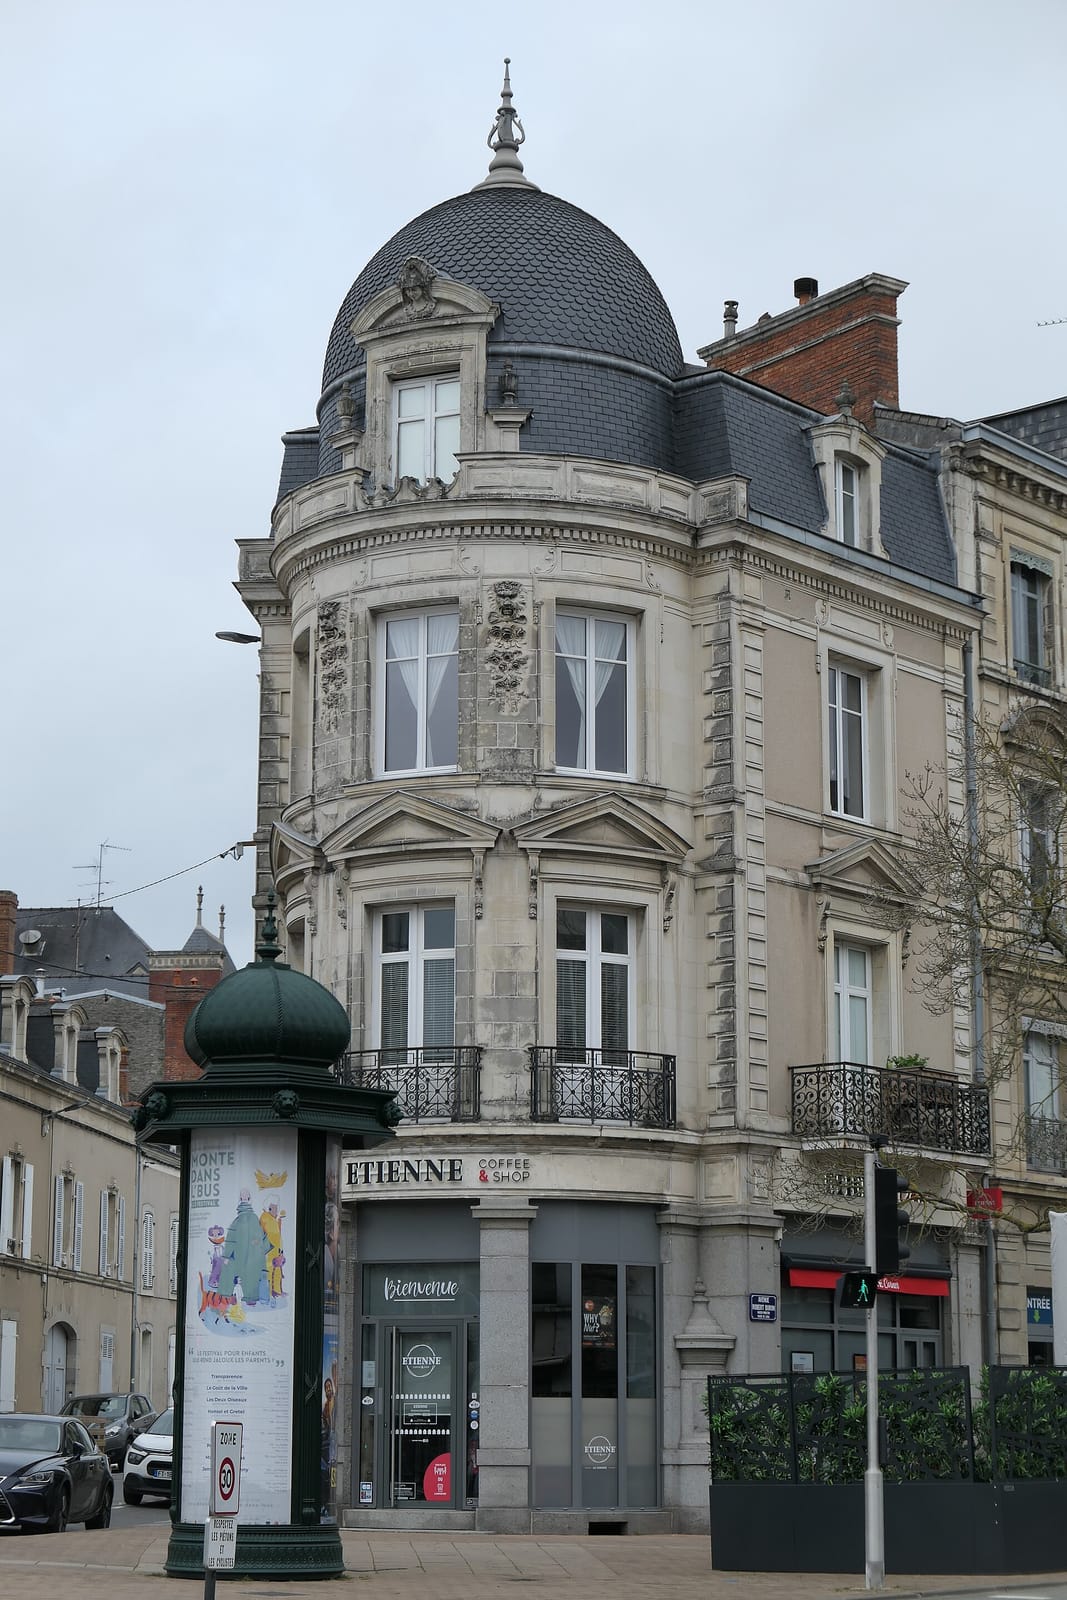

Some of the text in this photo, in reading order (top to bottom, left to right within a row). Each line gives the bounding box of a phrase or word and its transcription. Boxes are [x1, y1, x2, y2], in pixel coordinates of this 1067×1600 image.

[191, 1152, 235, 1168] MONTE
[478, 1159, 530, 1169] COFFEE
[191, 1168, 220, 1183] DANS
[346, 1159, 463, 1185] ETIENNE
[478, 1169, 530, 1182] & SHOP
[191, 1183, 220, 1198] L'BUS
[384, 1277, 459, 1300] Bienvenue
[1027, 1296, 1051, 1309] NTRÉE
[583, 1313, 598, 1323] WHY
[402, 1356, 442, 1365] ETIENNE
[220, 1432, 237, 1446] ZONE
[221, 1469, 232, 1489] 30
[213, 1520, 234, 1529] RESPECTEZ
[219, 1545, 225, 1554] ET
[216, 1557, 234, 1567] CYCLISTES
